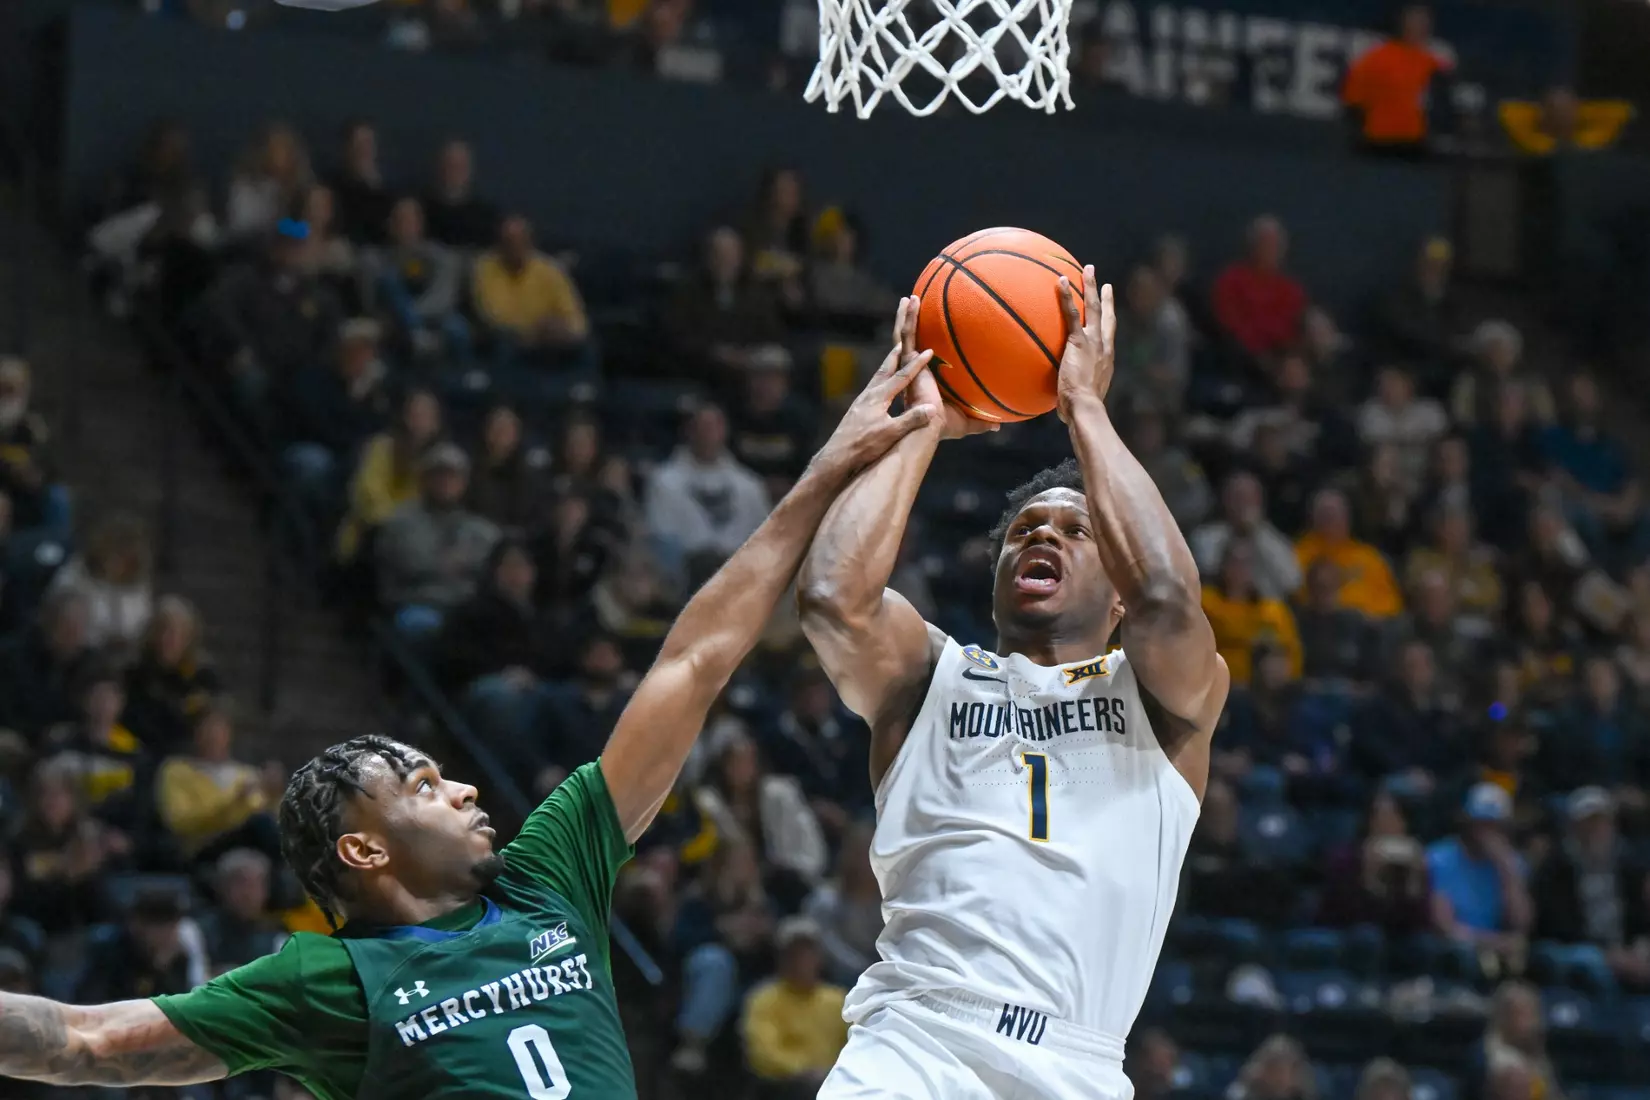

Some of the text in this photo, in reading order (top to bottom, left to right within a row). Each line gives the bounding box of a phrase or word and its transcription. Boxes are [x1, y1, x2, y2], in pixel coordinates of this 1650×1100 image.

[1064, 657, 1109, 686] XII
[1021, 751, 1051, 842] 1
[530, 920, 569, 959] NEC
[394, 953, 593, 1047] MERCYHURST
[995, 1002, 1048, 1046] WVU
[506, 1023, 572, 1100] 0
